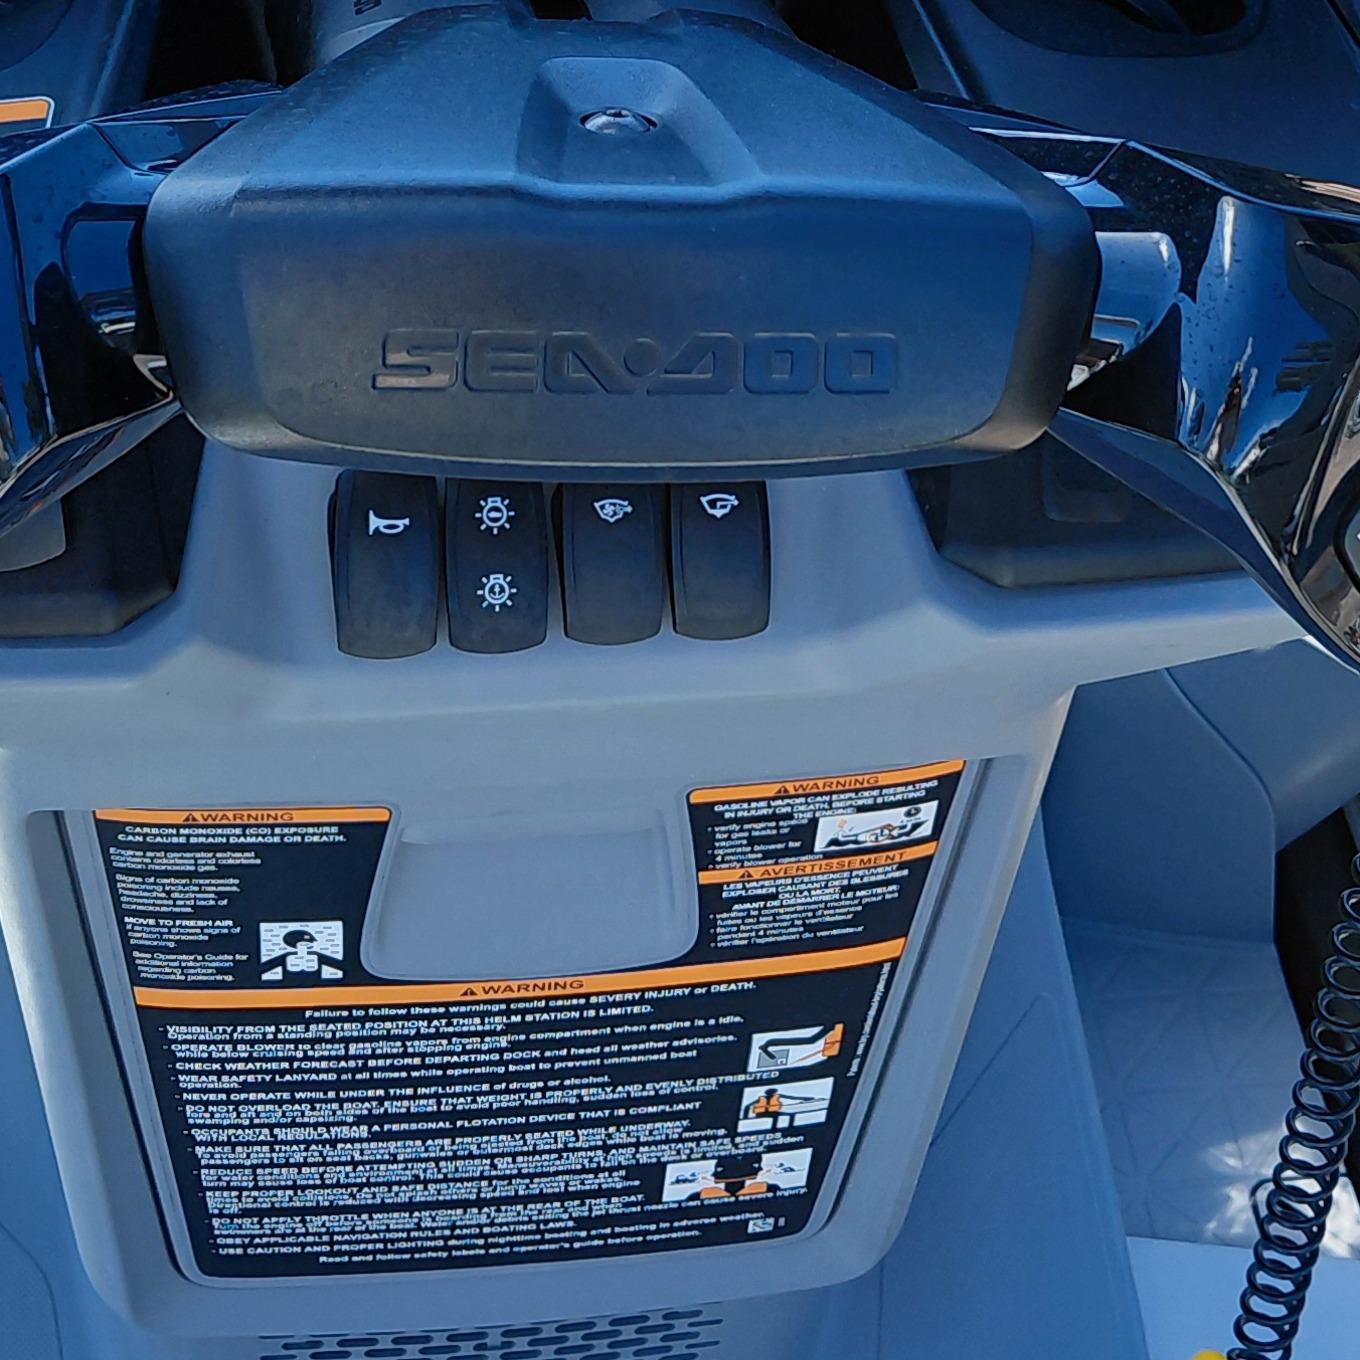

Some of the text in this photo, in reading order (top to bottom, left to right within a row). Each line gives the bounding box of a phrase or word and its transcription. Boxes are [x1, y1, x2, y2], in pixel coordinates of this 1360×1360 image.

[793, 778, 880, 792] WARNING
[201, 813, 295, 823] WARNING
[125, 827, 177, 835] CARBON
[245, 828, 272, 837] (CO)
[273, 827, 339, 835] EXPOSURE
[189, 836, 227, 844] BRAIN
[229, 836, 281, 844] DAMAGE
[304, 835, 346, 843] DEATH.
[760, 851, 907, 878] AVERTISSEMENT
[124, 917, 156, 926] MOVE
[175, 919, 213, 927] FRESH
[304, 1009, 350, 1018] Failure
[351, 1009, 366, 1017] to
[368, 1007, 408, 1016] follow
[410, 1005, 447, 1015] these
[448, 1002, 507, 1015] warnings
[510, 1000, 546, 1010] could
[548, 998, 587, 1007] cause
[644, 987, 692, 999] INJURY
[693, 987, 709, 995] or
[710, 981, 757, 993] DEATH.
[481, 981, 585, 995] WARNING
[166, 1005, 654, 1035] VISIBILITY FROM THE SEATED POSITION AT THIS HELM STATION IS LIMITED.
[237, 1044, 295, 1052] BLOWER
[298, 1043, 312, 1051] to
[314, 1042, 345, 1050] clear
[348, 1040, 402, 1051] gasoline
[405, 1039, 448, 1049] vapors
[451, 1036, 481, 1045] from
[484, 1034, 526, 1045] engine
[529, 1027, 611, 1042] compartment
[614, 1024, 647, 1034] when
[649, 1020, 691, 1033] engine
[694, 1019, 705, 1027] is
[719, 1015, 744, 1024] idle.
[176, 1033, 737, 1071] CHECK WEATHER FORECAST BEFORE DEPARTING DOCK and heed all weather advisories.
[178, 1075, 219, 1083] WEAR
[220, 1075, 273, 1083] SAFETY
[275, 1073, 338, 1082] LANYARD
[354, 1072, 371, 1080] all
[372, 1070, 408, 1079] times
[410, 1069, 444, 1078] while
[446, 1065, 506, 1077] operating
[508, 1063, 536, 1072] boat
[538, 1062, 552, 1070] to
[554, 1058, 601, 1071] prevent
[603, 1052, 668, 1065] unmanned
[670, 1049, 698, 1059] boat
[183, 1093, 227, 1101] NEVER
[230, 1092, 291, 1101] OPERATE
[294, 1091, 336, 1100] WHILE
[339, 1089, 385, 1098] UNDER
[389, 1088, 414, 1096] THE
[417, 1084, 490, 1095] INFLUENCE
[493, 1083, 507, 1091] of
[509, 1080, 544, 1091] drugs
[563, 1075, 612, 1086] alcohol.
[190, 1101, 702, 1136] OCCUPANTS SHOULD WEAR A PERSONAL FLOTATION DEVICE THAT IS COMPLIANT
